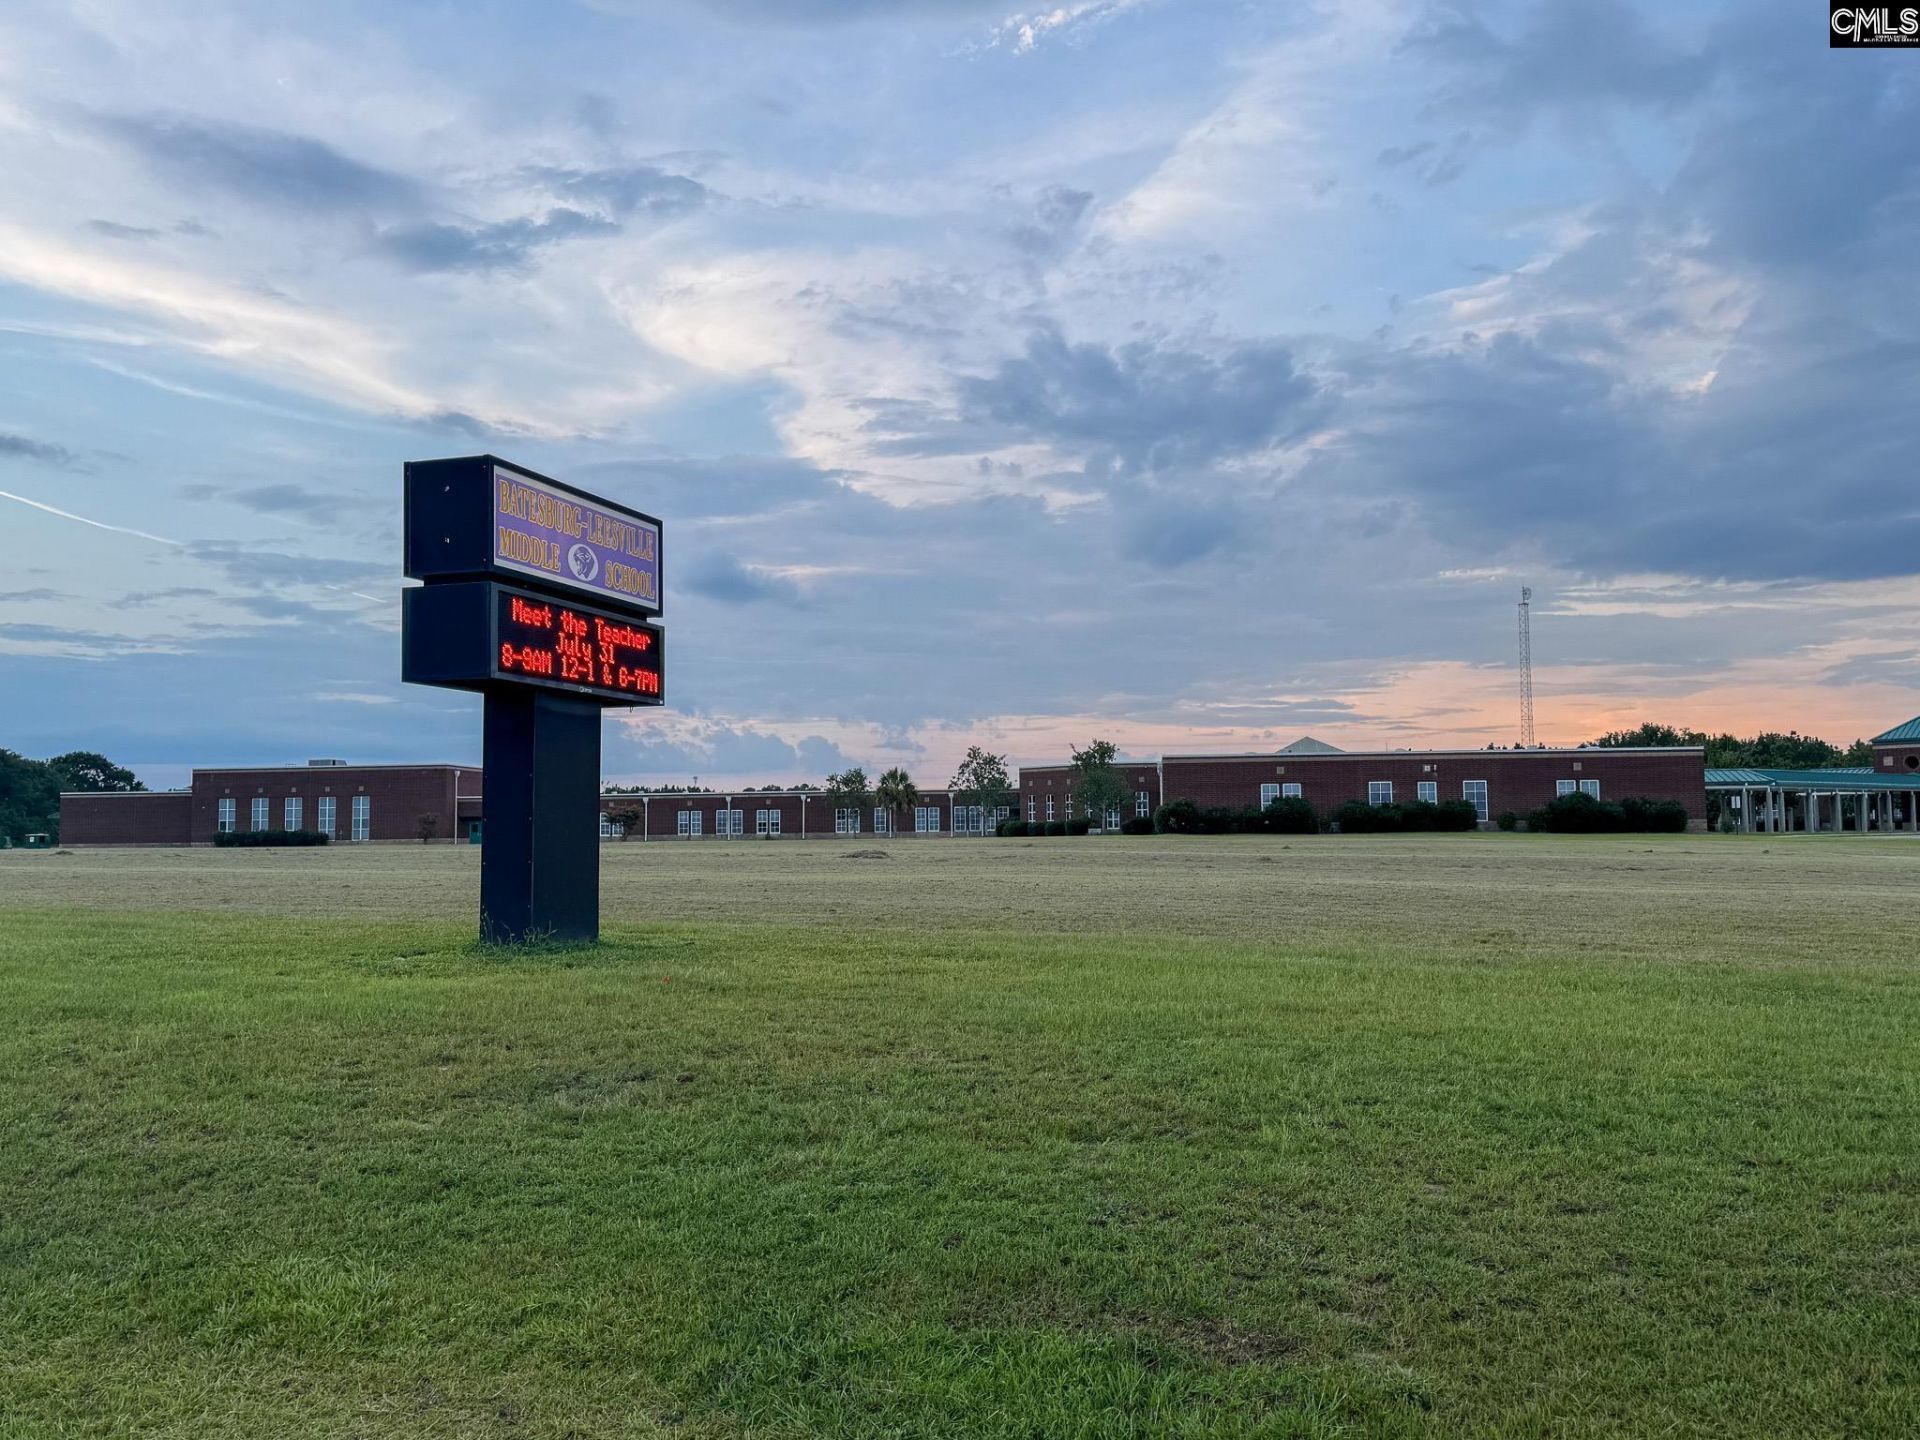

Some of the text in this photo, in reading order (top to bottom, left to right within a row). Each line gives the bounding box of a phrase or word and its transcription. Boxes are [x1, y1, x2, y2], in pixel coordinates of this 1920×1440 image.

[499, 479, 655, 562] BATESBURG-LEESVILLE
[499, 526, 655, 600] MIDDLE SCHOOL
[512, 597, 651, 650] Meet the Teacher
[556, 632, 615, 665] July 31
[502, 643, 552, 675] 8-9AM
[561, 655, 595, 682] 12-1
[603, 663, 613, 686] &
